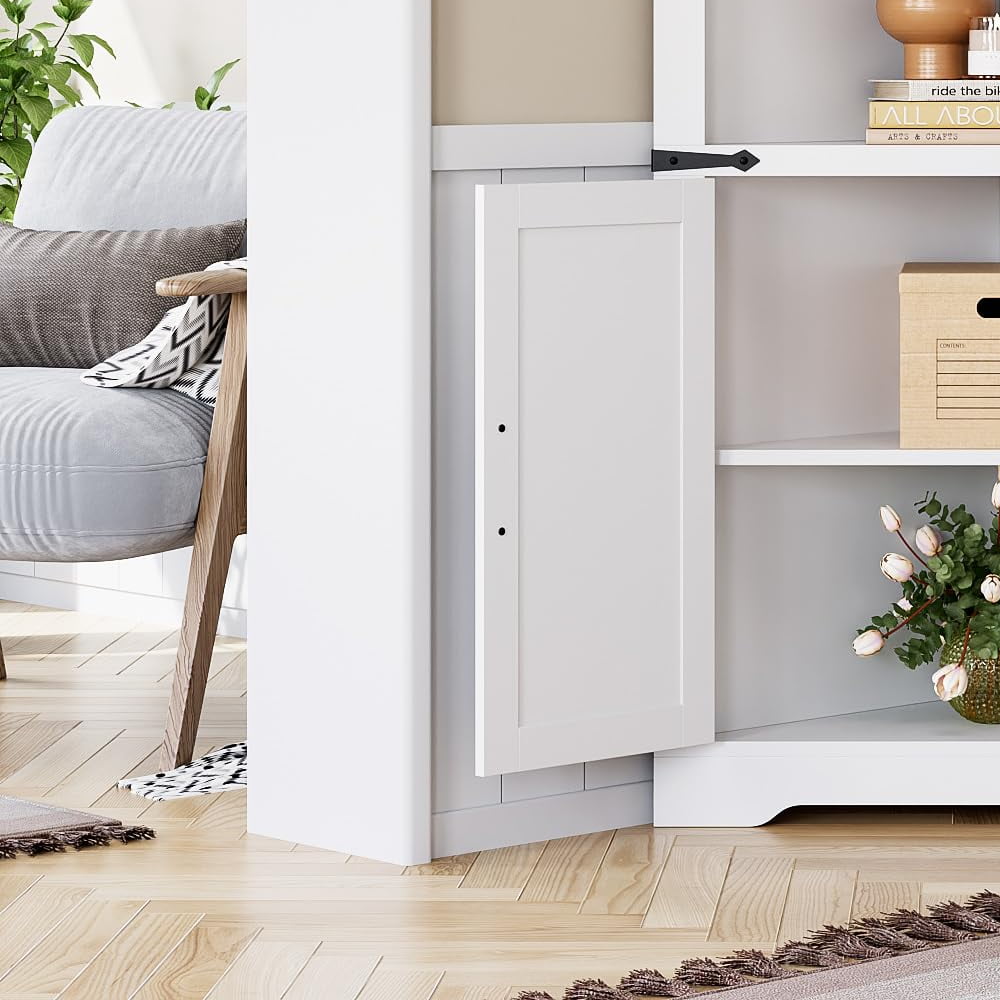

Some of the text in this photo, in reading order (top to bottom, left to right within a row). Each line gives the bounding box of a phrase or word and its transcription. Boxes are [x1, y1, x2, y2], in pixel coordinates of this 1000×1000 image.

[931, 85, 957, 96] ride
[960, 85, 981, 96] the
[882, 106, 927, 126] ALL
[887, 132, 959, 141] ARTS & CRAFTS
